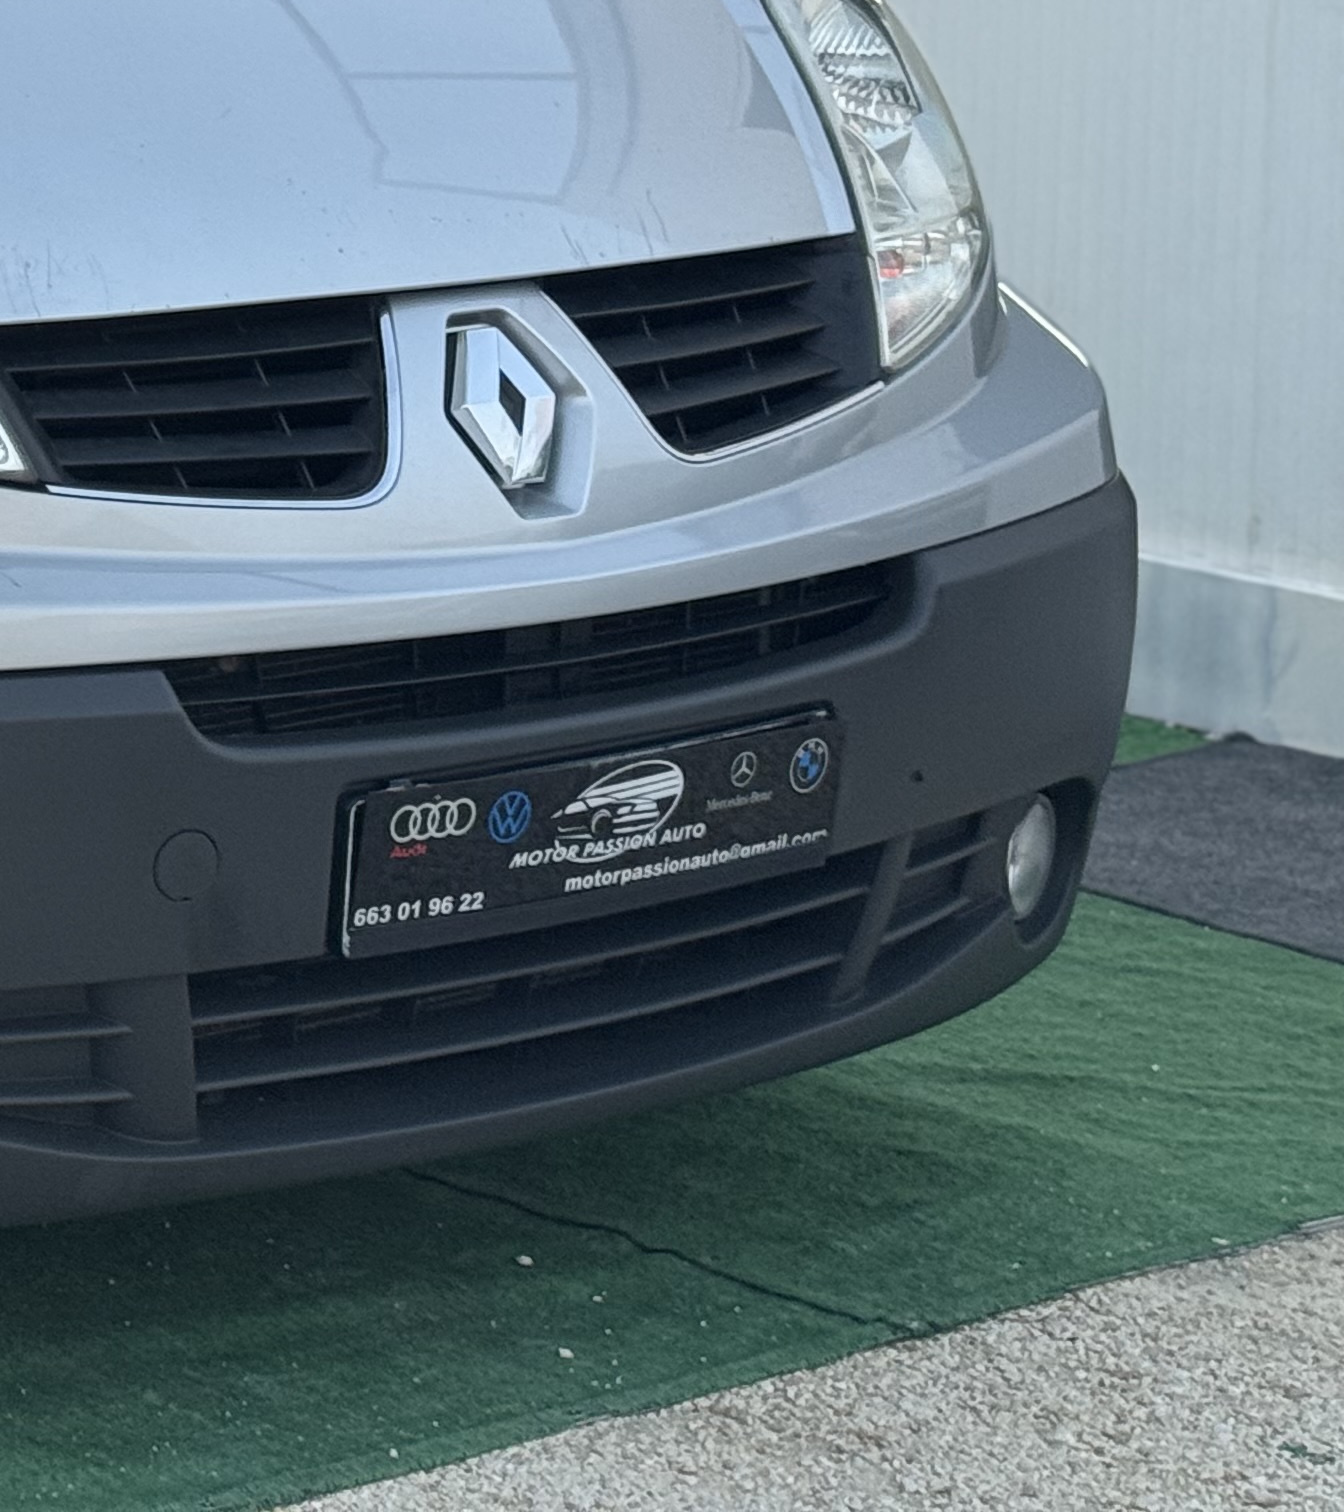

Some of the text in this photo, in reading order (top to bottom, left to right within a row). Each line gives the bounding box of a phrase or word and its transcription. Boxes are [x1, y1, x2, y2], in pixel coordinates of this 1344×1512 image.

[390, 842, 428, 859] Audi
[509, 822, 707, 870] MOTOR PASSION AUTO
[353, 891, 485, 927] 663 01 96 22
